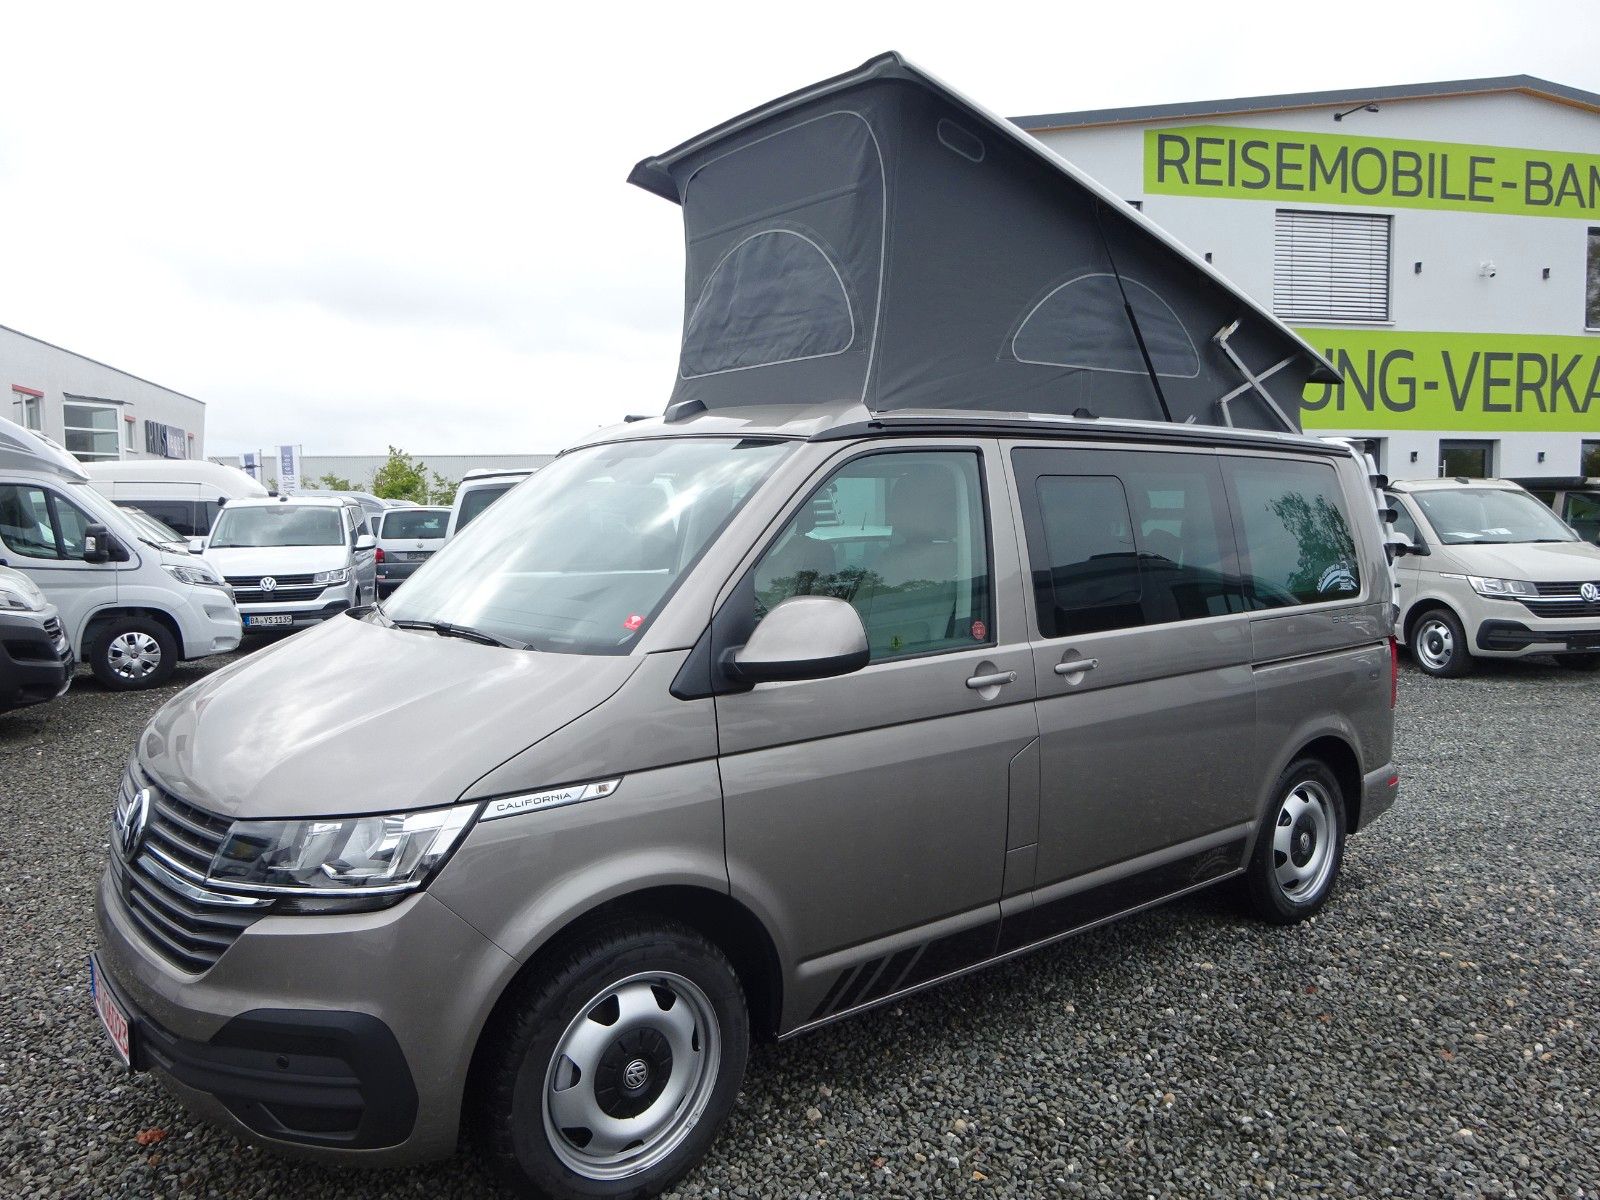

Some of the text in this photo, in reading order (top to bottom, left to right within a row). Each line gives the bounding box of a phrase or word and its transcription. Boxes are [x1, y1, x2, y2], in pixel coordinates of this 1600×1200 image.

[264, 616, 273, 624] YS
[274, 615, 292, 624] 1135
[496, 792, 572, 812] CALIFORNIA
